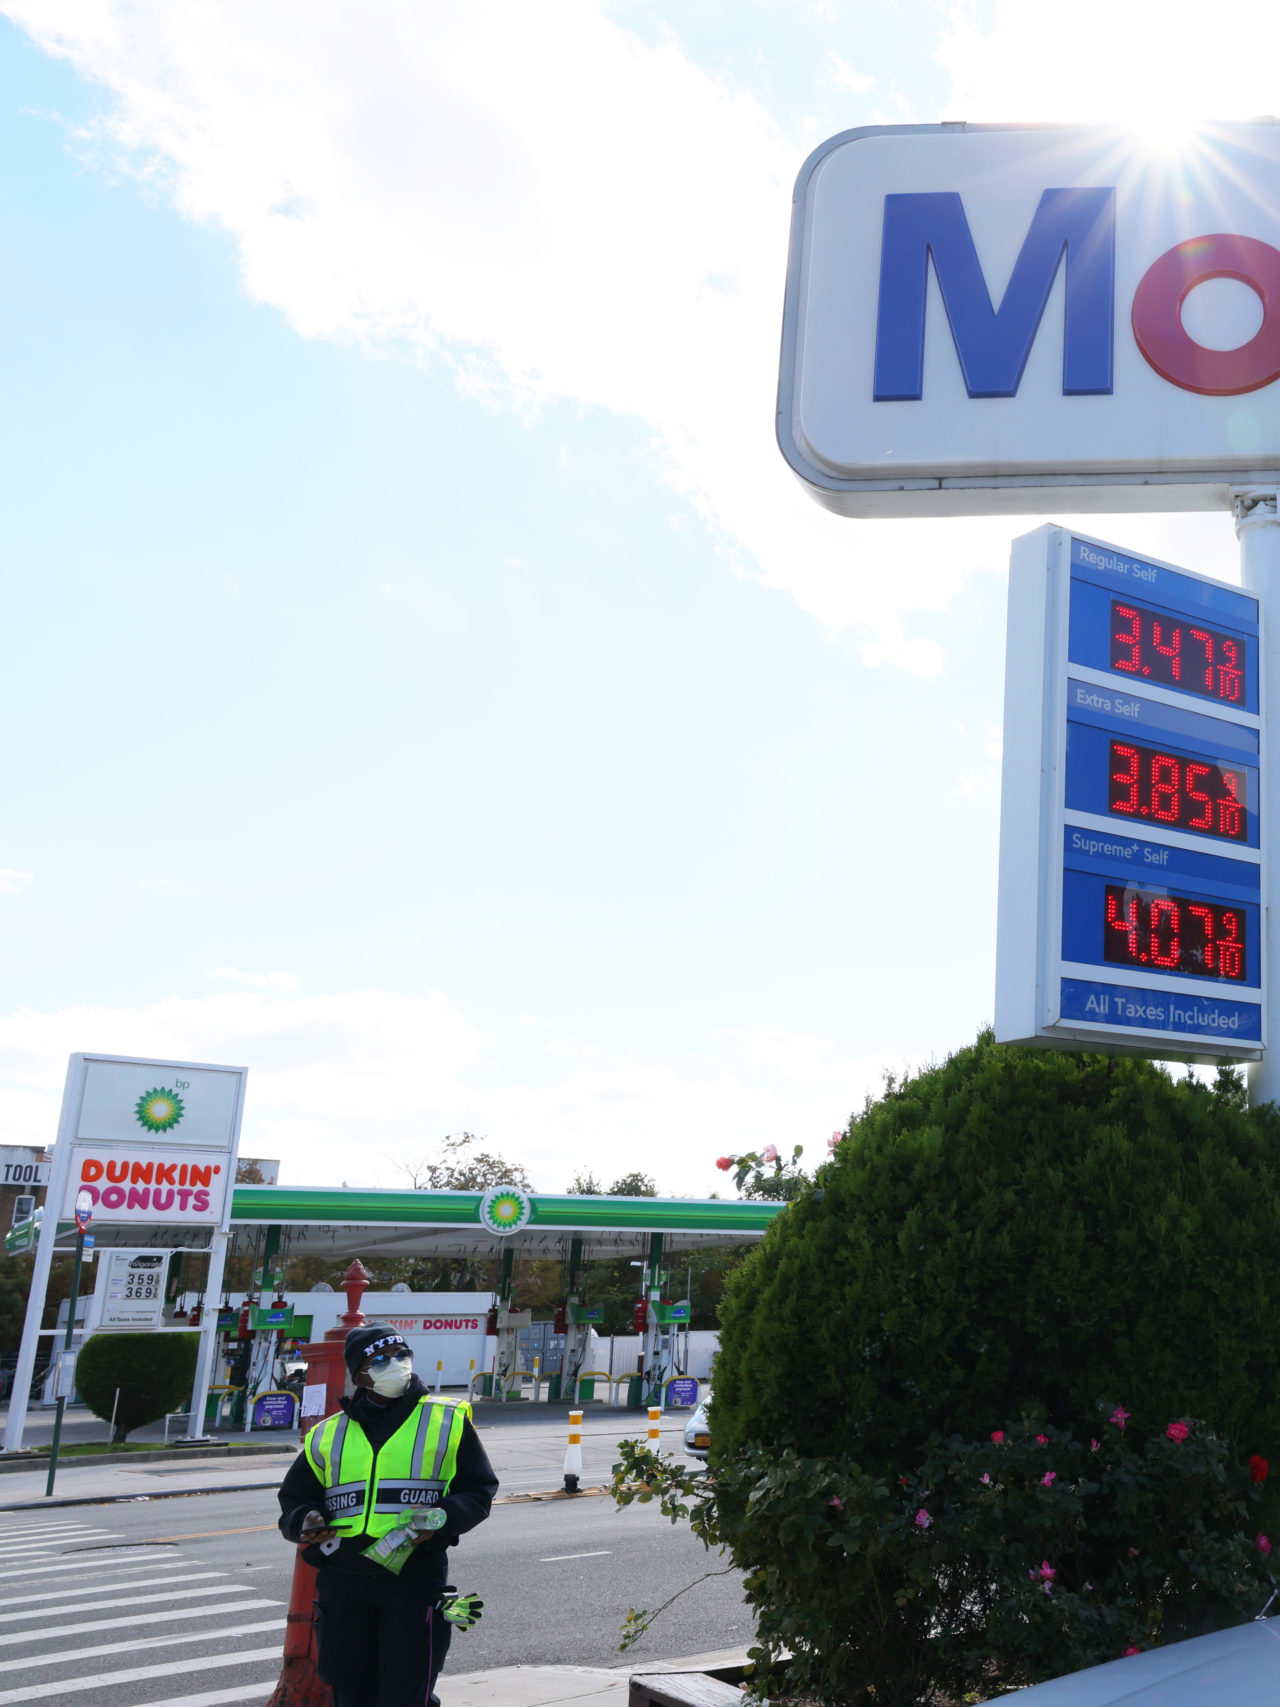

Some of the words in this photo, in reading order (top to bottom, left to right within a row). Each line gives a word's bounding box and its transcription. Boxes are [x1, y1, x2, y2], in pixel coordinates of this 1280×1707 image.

[1079, 546, 1130, 574] Regular
[1132, 564, 1158, 583] Self
[1076, 688, 1112, 711] Extra
[1114, 696, 1142, 718] Self
[1143, 847, 1169, 866] Self
[1084, 994, 1109, 1013] All
[1114, 998, 1165, 1020] Taxes
[1169, 1004, 1239, 1029] Included
[175, 1078, 190, 1090] bp
[4, 1164, 42, 1183] TOOL
[80, 1158, 221, 1188] DUNKIN'
[79, 1184, 210, 1212] DONUTS
[423, 1318, 479, 1330] DONUTS
[363, 1335, 404, 1357] NYPD
[400, 1489, 439, 1504] GUARD
